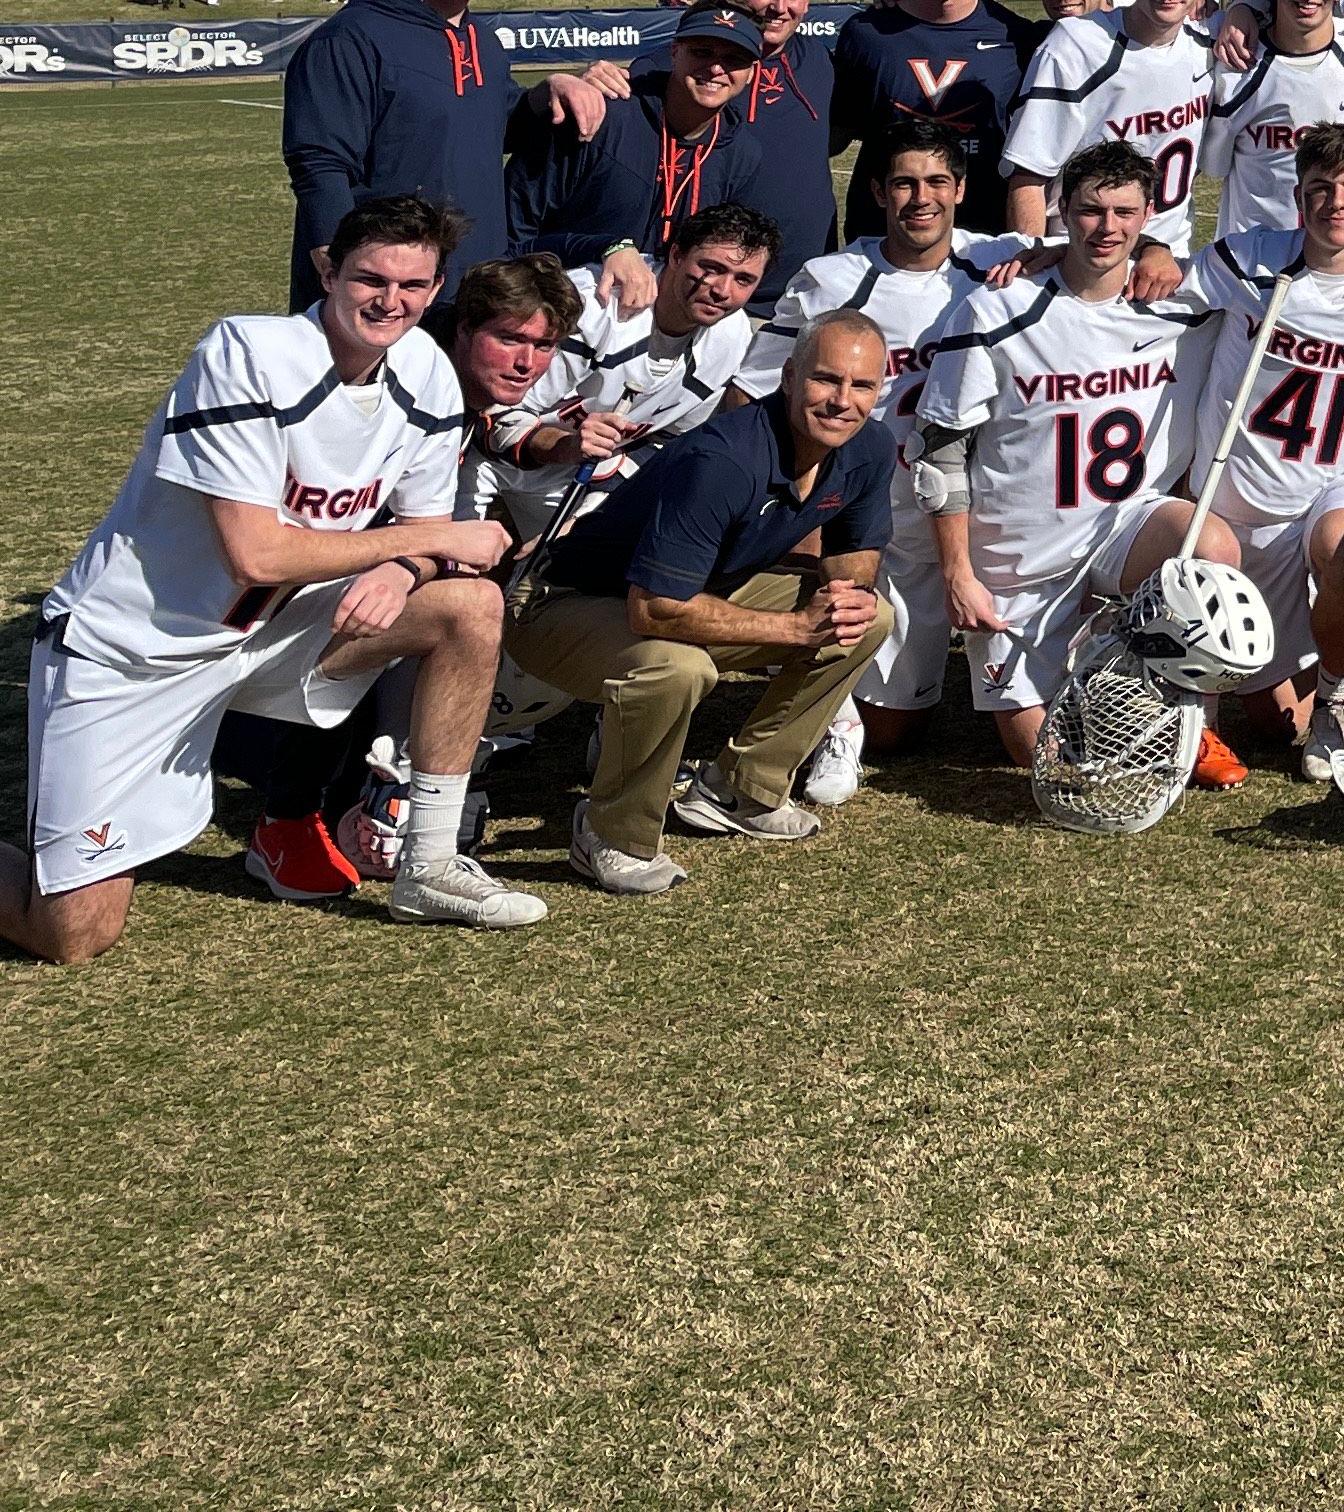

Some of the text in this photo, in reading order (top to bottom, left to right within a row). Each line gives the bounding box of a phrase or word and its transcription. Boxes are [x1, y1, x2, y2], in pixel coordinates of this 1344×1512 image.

[124, 31, 236, 42] SELECT SECTOR
[795, 21, 836, 36] DICS
[1105, 94, 1209, 141] VIRGINI
[1012, 357, 1178, 404] VIRGINIA
[1055, 406, 1147, 509] 18
